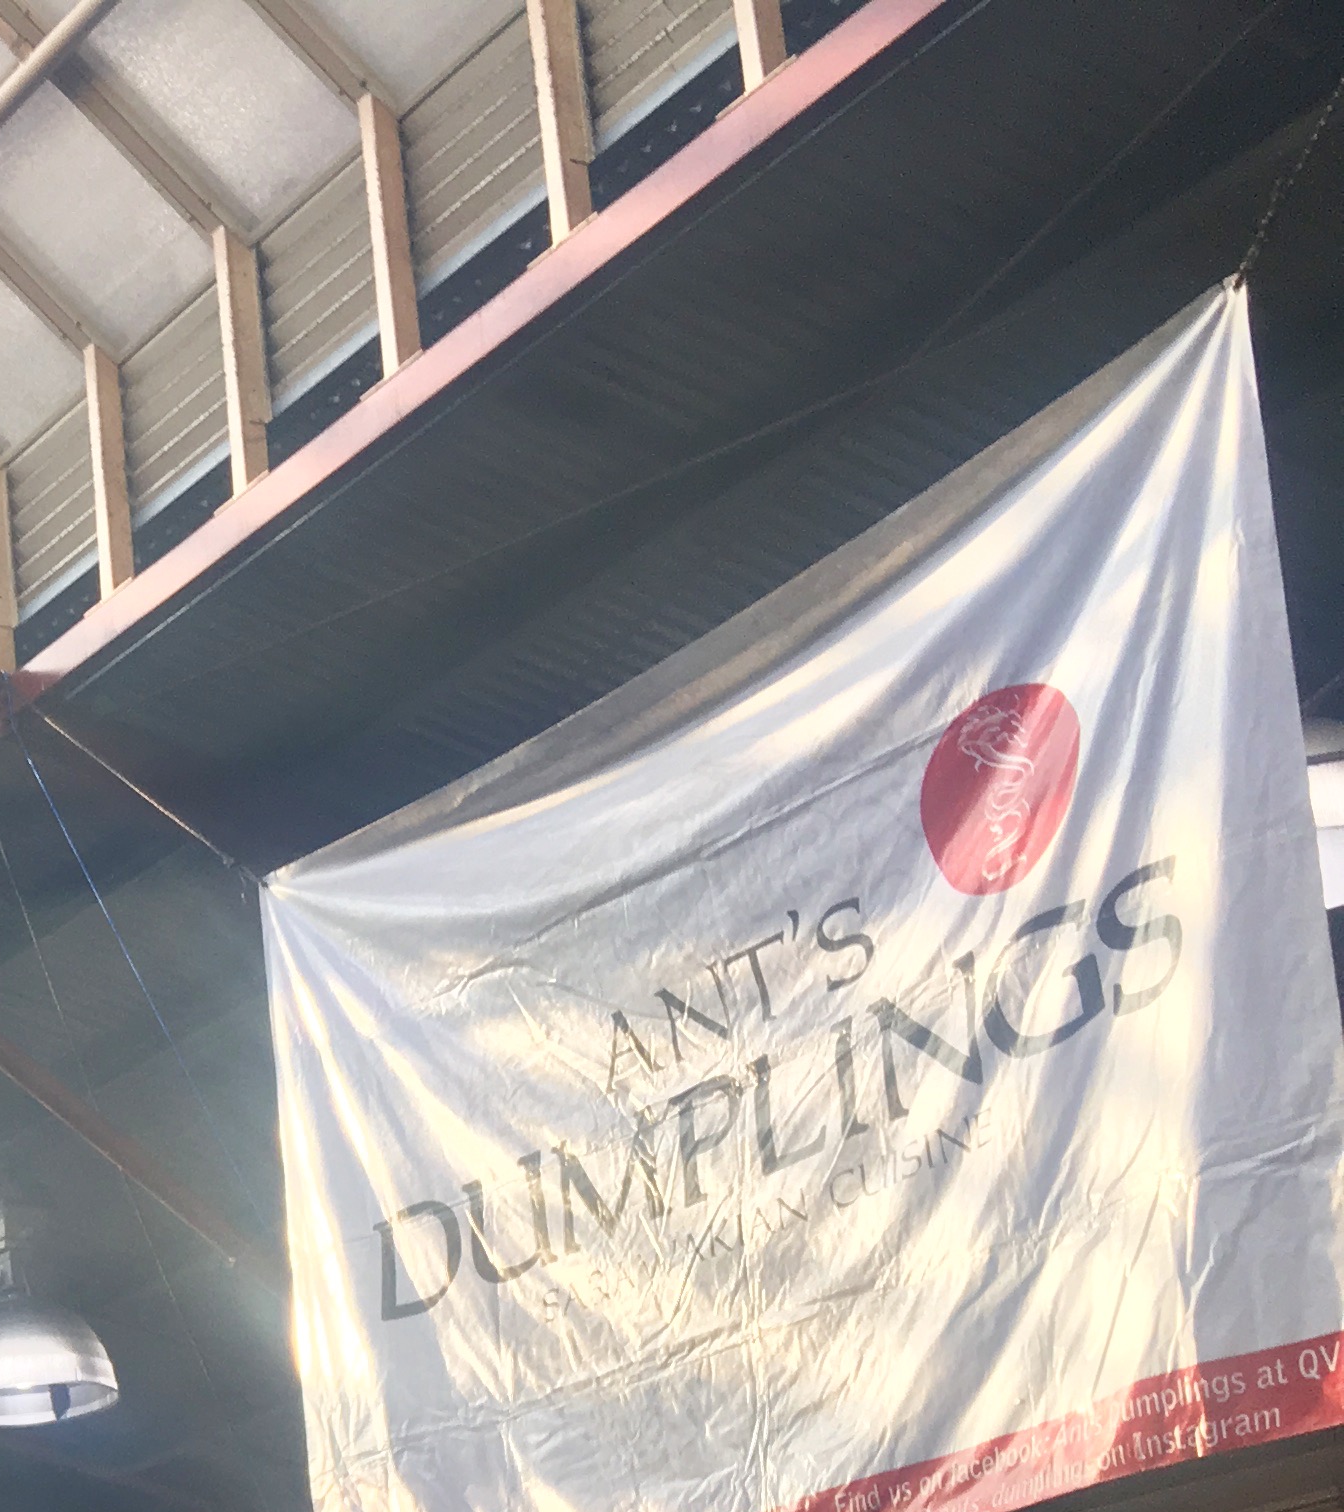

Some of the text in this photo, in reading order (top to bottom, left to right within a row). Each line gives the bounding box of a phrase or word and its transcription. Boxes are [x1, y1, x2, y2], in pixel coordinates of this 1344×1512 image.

[606, 896, 875, 1094] ANT'S
[373, 855, 1183, 1322] DUMPLINGS
[827, 1108, 994, 1208] CUISINE
[1257, 1358, 1288, 1389] at
[1098, 1445, 1125, 1471] on
[1132, 1407, 1280, 1461] Instagram
